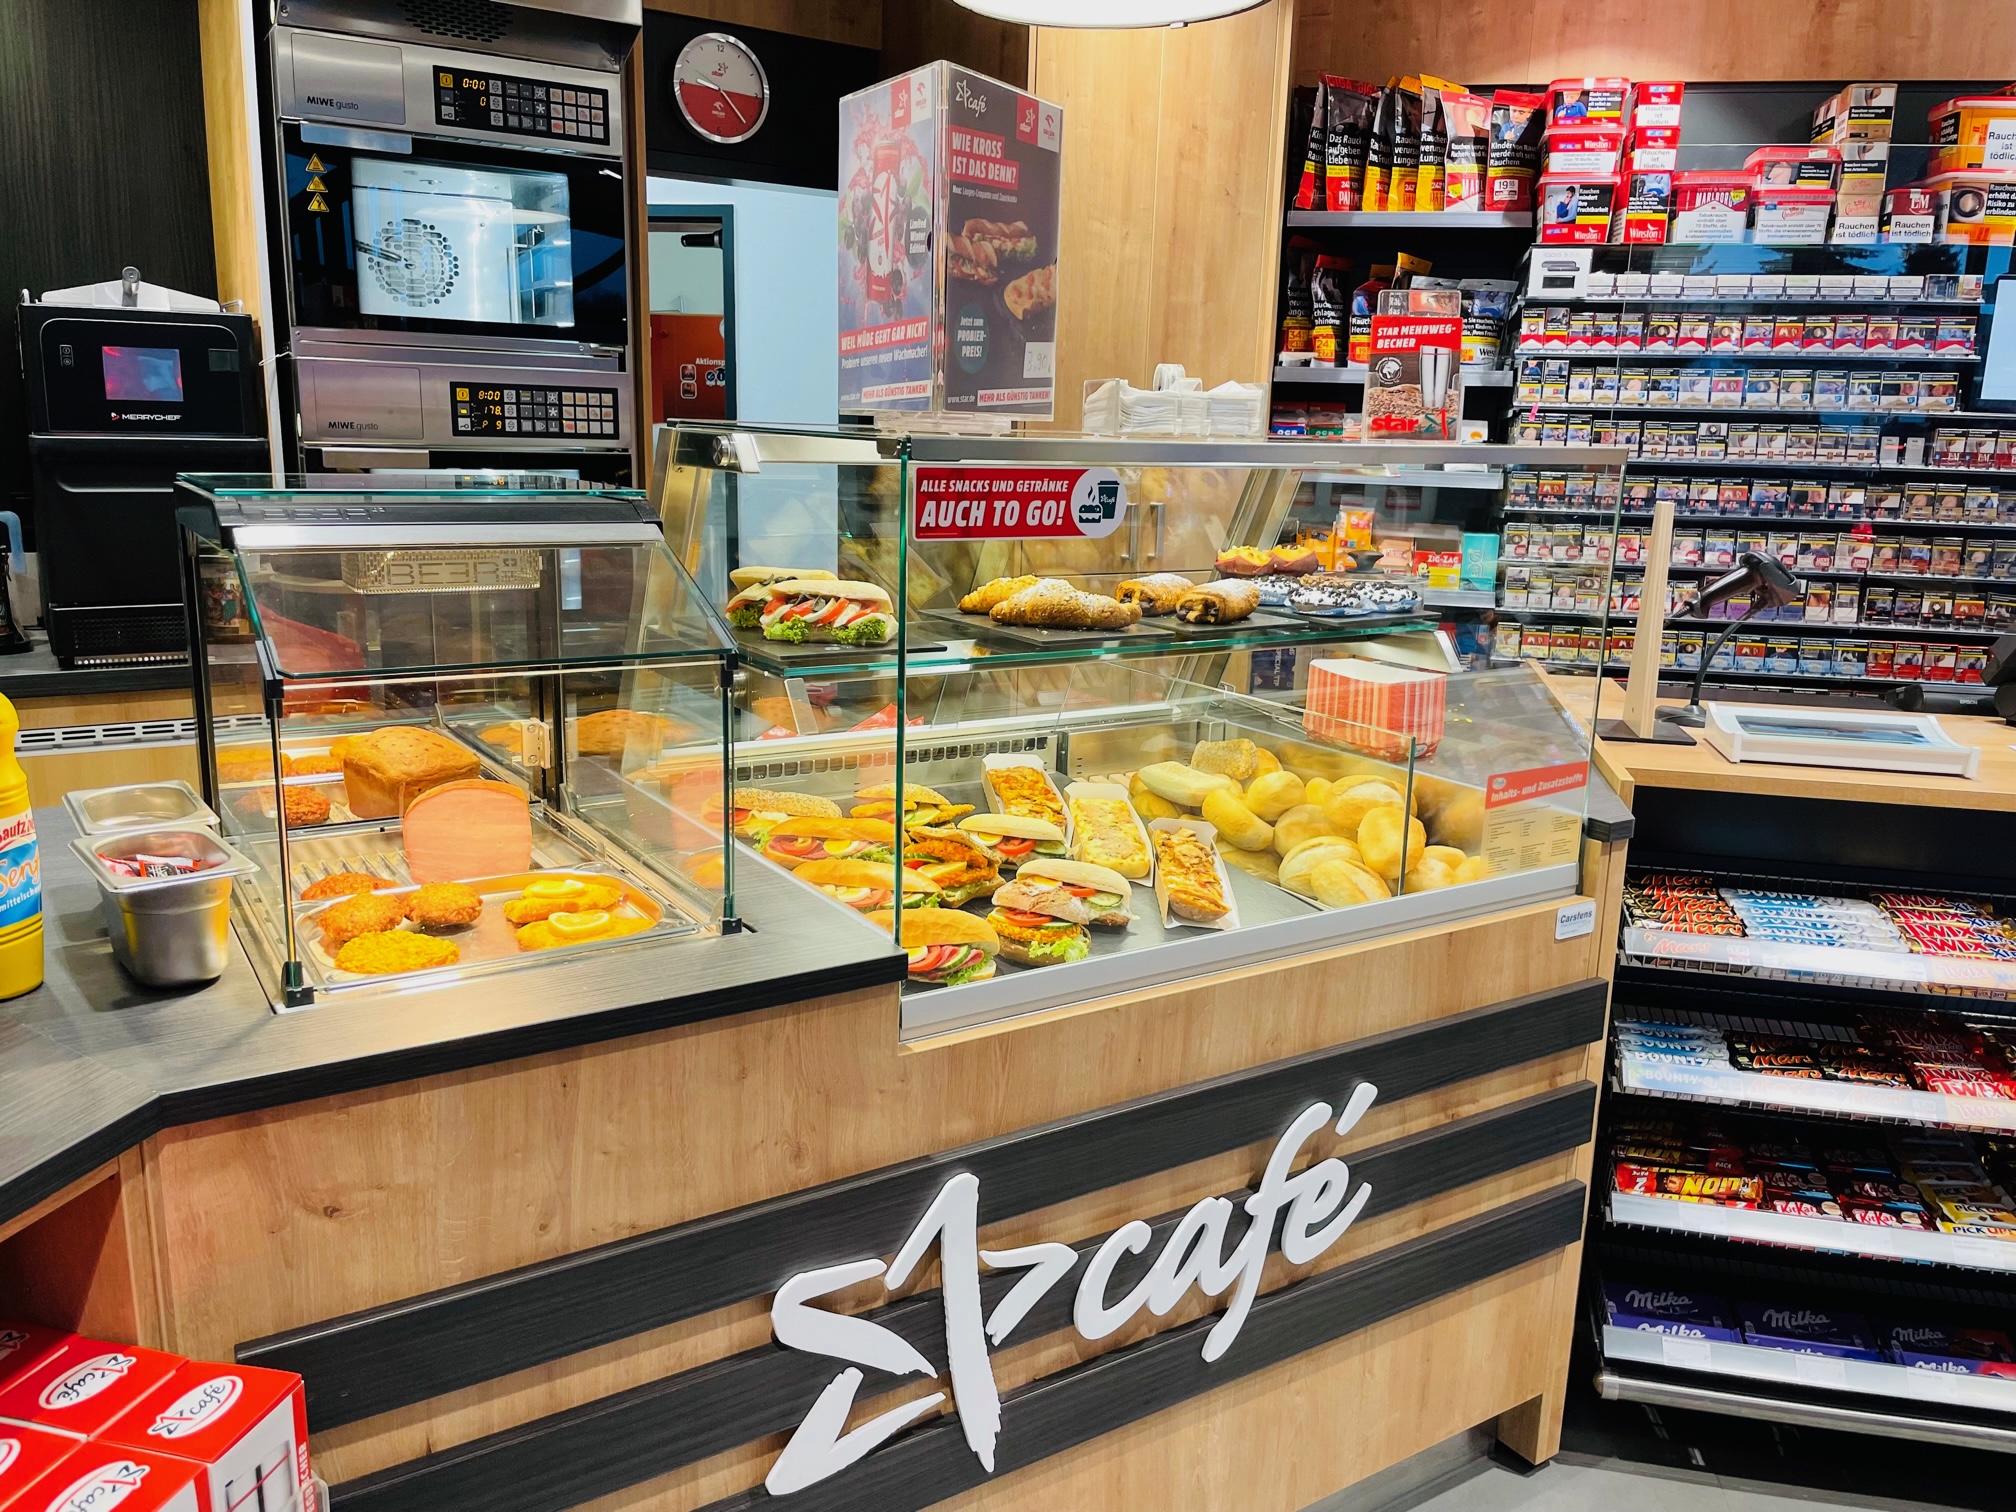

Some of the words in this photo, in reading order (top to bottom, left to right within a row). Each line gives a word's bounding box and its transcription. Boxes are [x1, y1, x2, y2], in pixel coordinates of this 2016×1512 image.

[717, 44, 725, 52] 12
[463, 77, 486, 90] 0:00
[306, 95, 335, 107] MIWE
[336, 99, 359, 112] gusto
[968, 96, 987, 117] café
[952, 131, 971, 152] WIE
[973, 136, 1002, 158] KROSS
[1329, 133, 1342, 143] Das
[1584, 139, 1609, 149] Winston
[1328, 144, 1361, 155] aufgeben
[1490, 150, 1515, 158] werden
[952, 155, 967, 175] IST
[968, 159, 987, 178] DAS
[988, 162, 1017, 184] DENN?
[1988, 191, 2010, 199] erhöht
[1894, 221, 1931, 229] Rauchen
[1574, 229, 1599, 240] Winston
[1630, 227, 1658, 239] Winston
[1847, 230, 1876, 238] tödlich
[1903, 229, 1931, 237] tödlich
[841, 335, 856, 351] WEIL
[857, 330, 874, 348] MÜDE
[875, 328, 891, 345] GEHT
[891, 325, 906, 341] GAR
[906, 321, 927, 339] NICHT
[957, 329, 987, 341] PROBIER-
[1377, 326, 1399, 336] STAR
[1400, 324, 1456, 336] MEHRWEG-
[1376, 338, 1416, 349] BECHER
[893, 344, 928, 362] Wachmacher!
[961, 345, 983, 357] PREIS!
[478, 390, 500, 401] 8:00
[863, 390, 875, 399] MEHR
[875, 388, 884, 398] ALS
[884, 385, 904, 398] GÜNSTIG
[905, 383, 928, 396] TANKEN!
[979, 393, 995, 403] MEHR
[996, 392, 1005, 401] ALS
[1006, 390, 1028, 401] GÜNSTIG
[1029, 390, 1050, 400] TANKEN!
[947, 394, 975, 404] www.star.de
[121, 413, 182, 421] MERRYCHEF
[1370, 413, 1419, 433] star
[328, 420, 355, 431] MIWE
[356, 422, 379, 432] gusto
[920, 479, 947, 492] ALLE
[948, 479, 990, 493] SNACKS
[991, 480, 1014, 493] UND
[1016, 478, 1069, 493] GETRÄNKE
[919, 500, 986, 528] AUCH
[993, 500, 1020, 527] TO
[1026, 500, 1067, 527] GO!
[1427, 554, 1459, 564] ZIG-ZAG
[1490, 789, 1520, 803] Inhalts-
[1522, 784, 1537, 796] und
[1537, 772, 1584, 792] Zusatzstoffe
[1642, 884, 1718, 898] Mars
[1652, 896, 1731, 913] Mars
[1870, 892, 1950, 907] TWIX
[1560, 910, 1593, 924] Carstens
[1660, 910, 1742, 924] Mars
[1888, 909, 1966, 923] TWIX
[1662, 920, 1743, 936] Mars
[1896, 922, 1978, 938] TWIX
[1653, 938, 1712, 954] Mars
[1908, 936, 1992, 953] TWIX
[1631, 1039, 1704, 1053] BOUNTY
[1634, 1051, 1709, 1067] BOUNTY
[1753, 1054, 1814, 1068] Mars
[1645, 1069, 1697, 1085] BOUNTY
[1838, 1066, 1907, 1081] Mars
[1916, 1066, 1991, 1082] TWIX
[1930, 1078, 2010, 1099] TWIX
[1779, 1201, 1816, 1215] KitKat
[1954, 1203, 1985, 1213] PiCK
[1073, 1081, 1379, 1363] café
[1859, 1210, 1896, 1226] KitKat
[1953, 1224, 1985, 1235] PiCK
[1625, 1288, 1693, 1310] Milka
[1762, 1308, 1831, 1329] Milka
[1892, 1327, 1946, 1343] Milka
[189, 1382, 227, 1415] café
